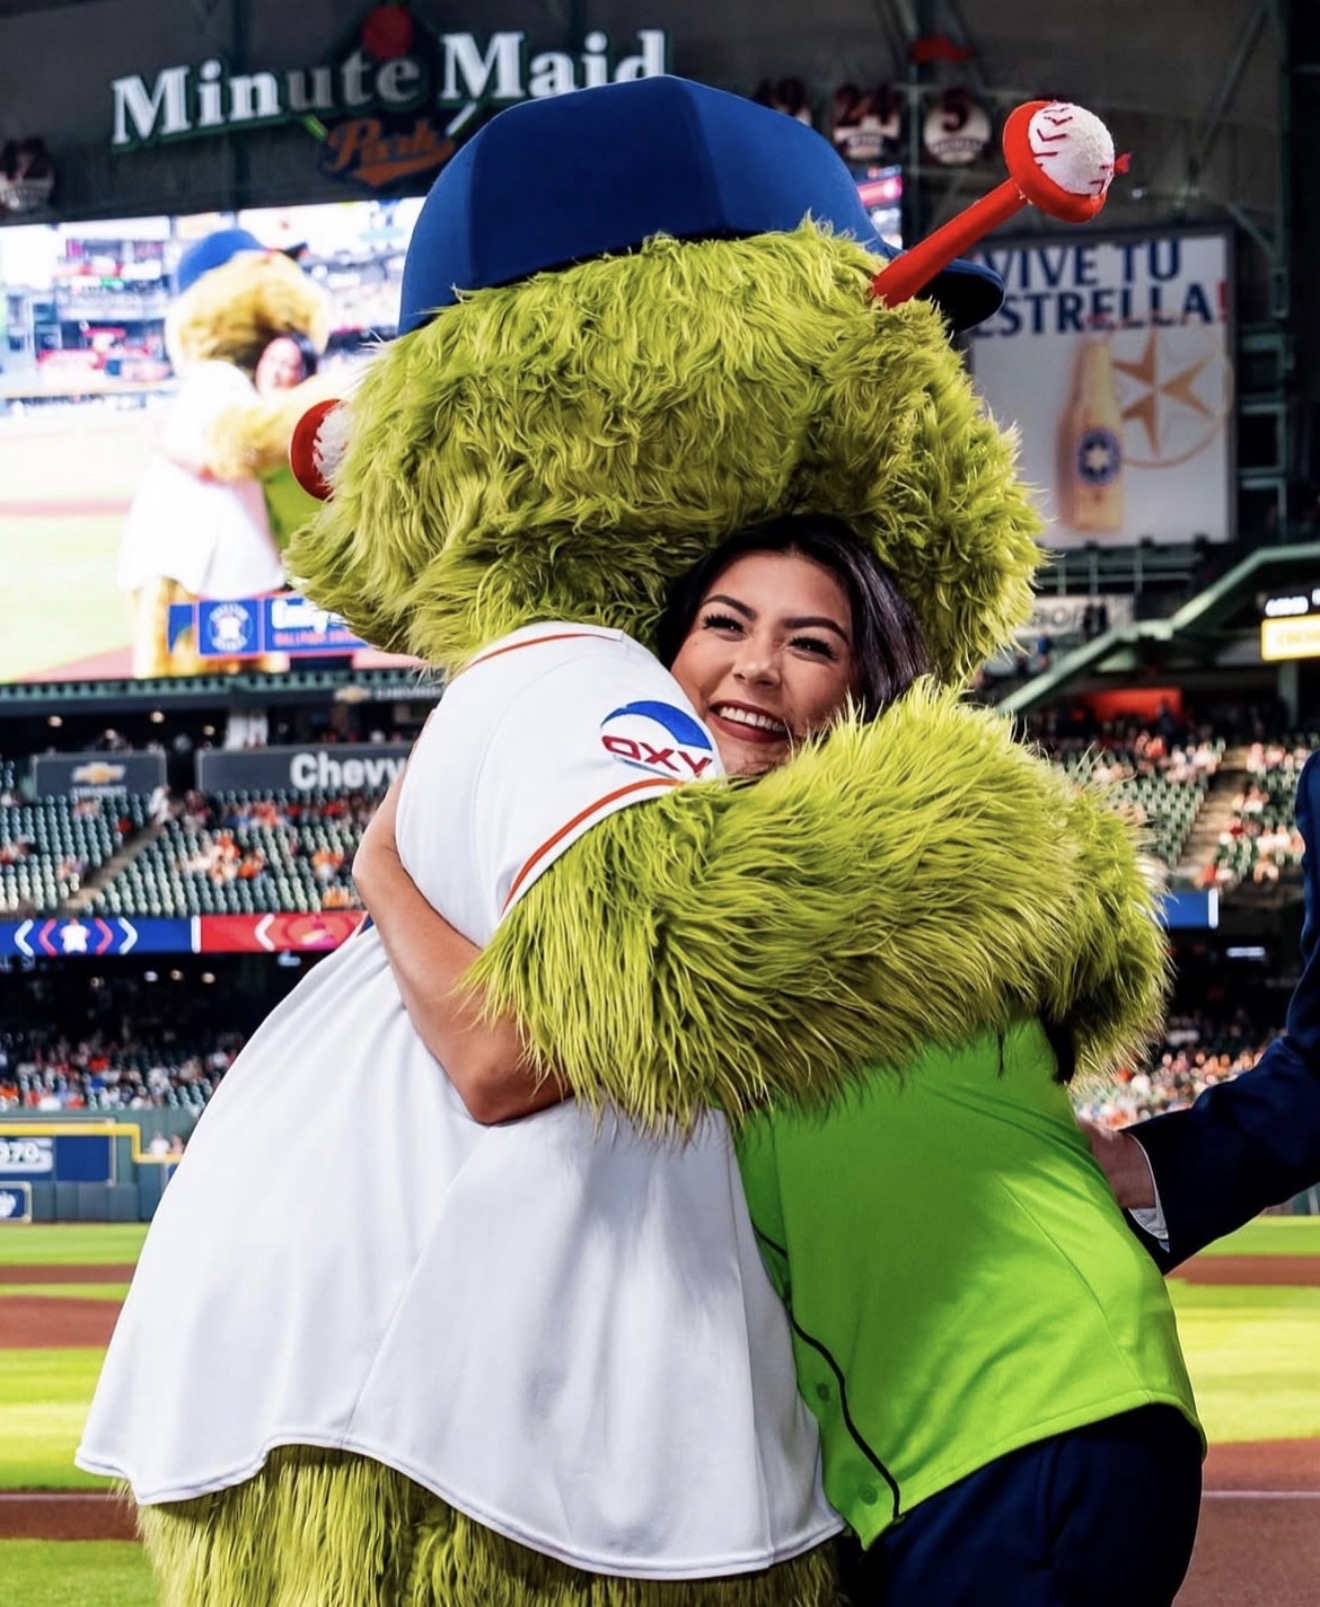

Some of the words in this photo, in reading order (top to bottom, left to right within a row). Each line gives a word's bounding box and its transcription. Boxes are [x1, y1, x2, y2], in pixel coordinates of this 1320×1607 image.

[111, 55, 421, 145] Minute
[441, 29, 667, 101] Maid
[942, 86, 971, 132] 5
[1121, 238, 1181, 282] TU
[601, 735, 713, 778] OXY
